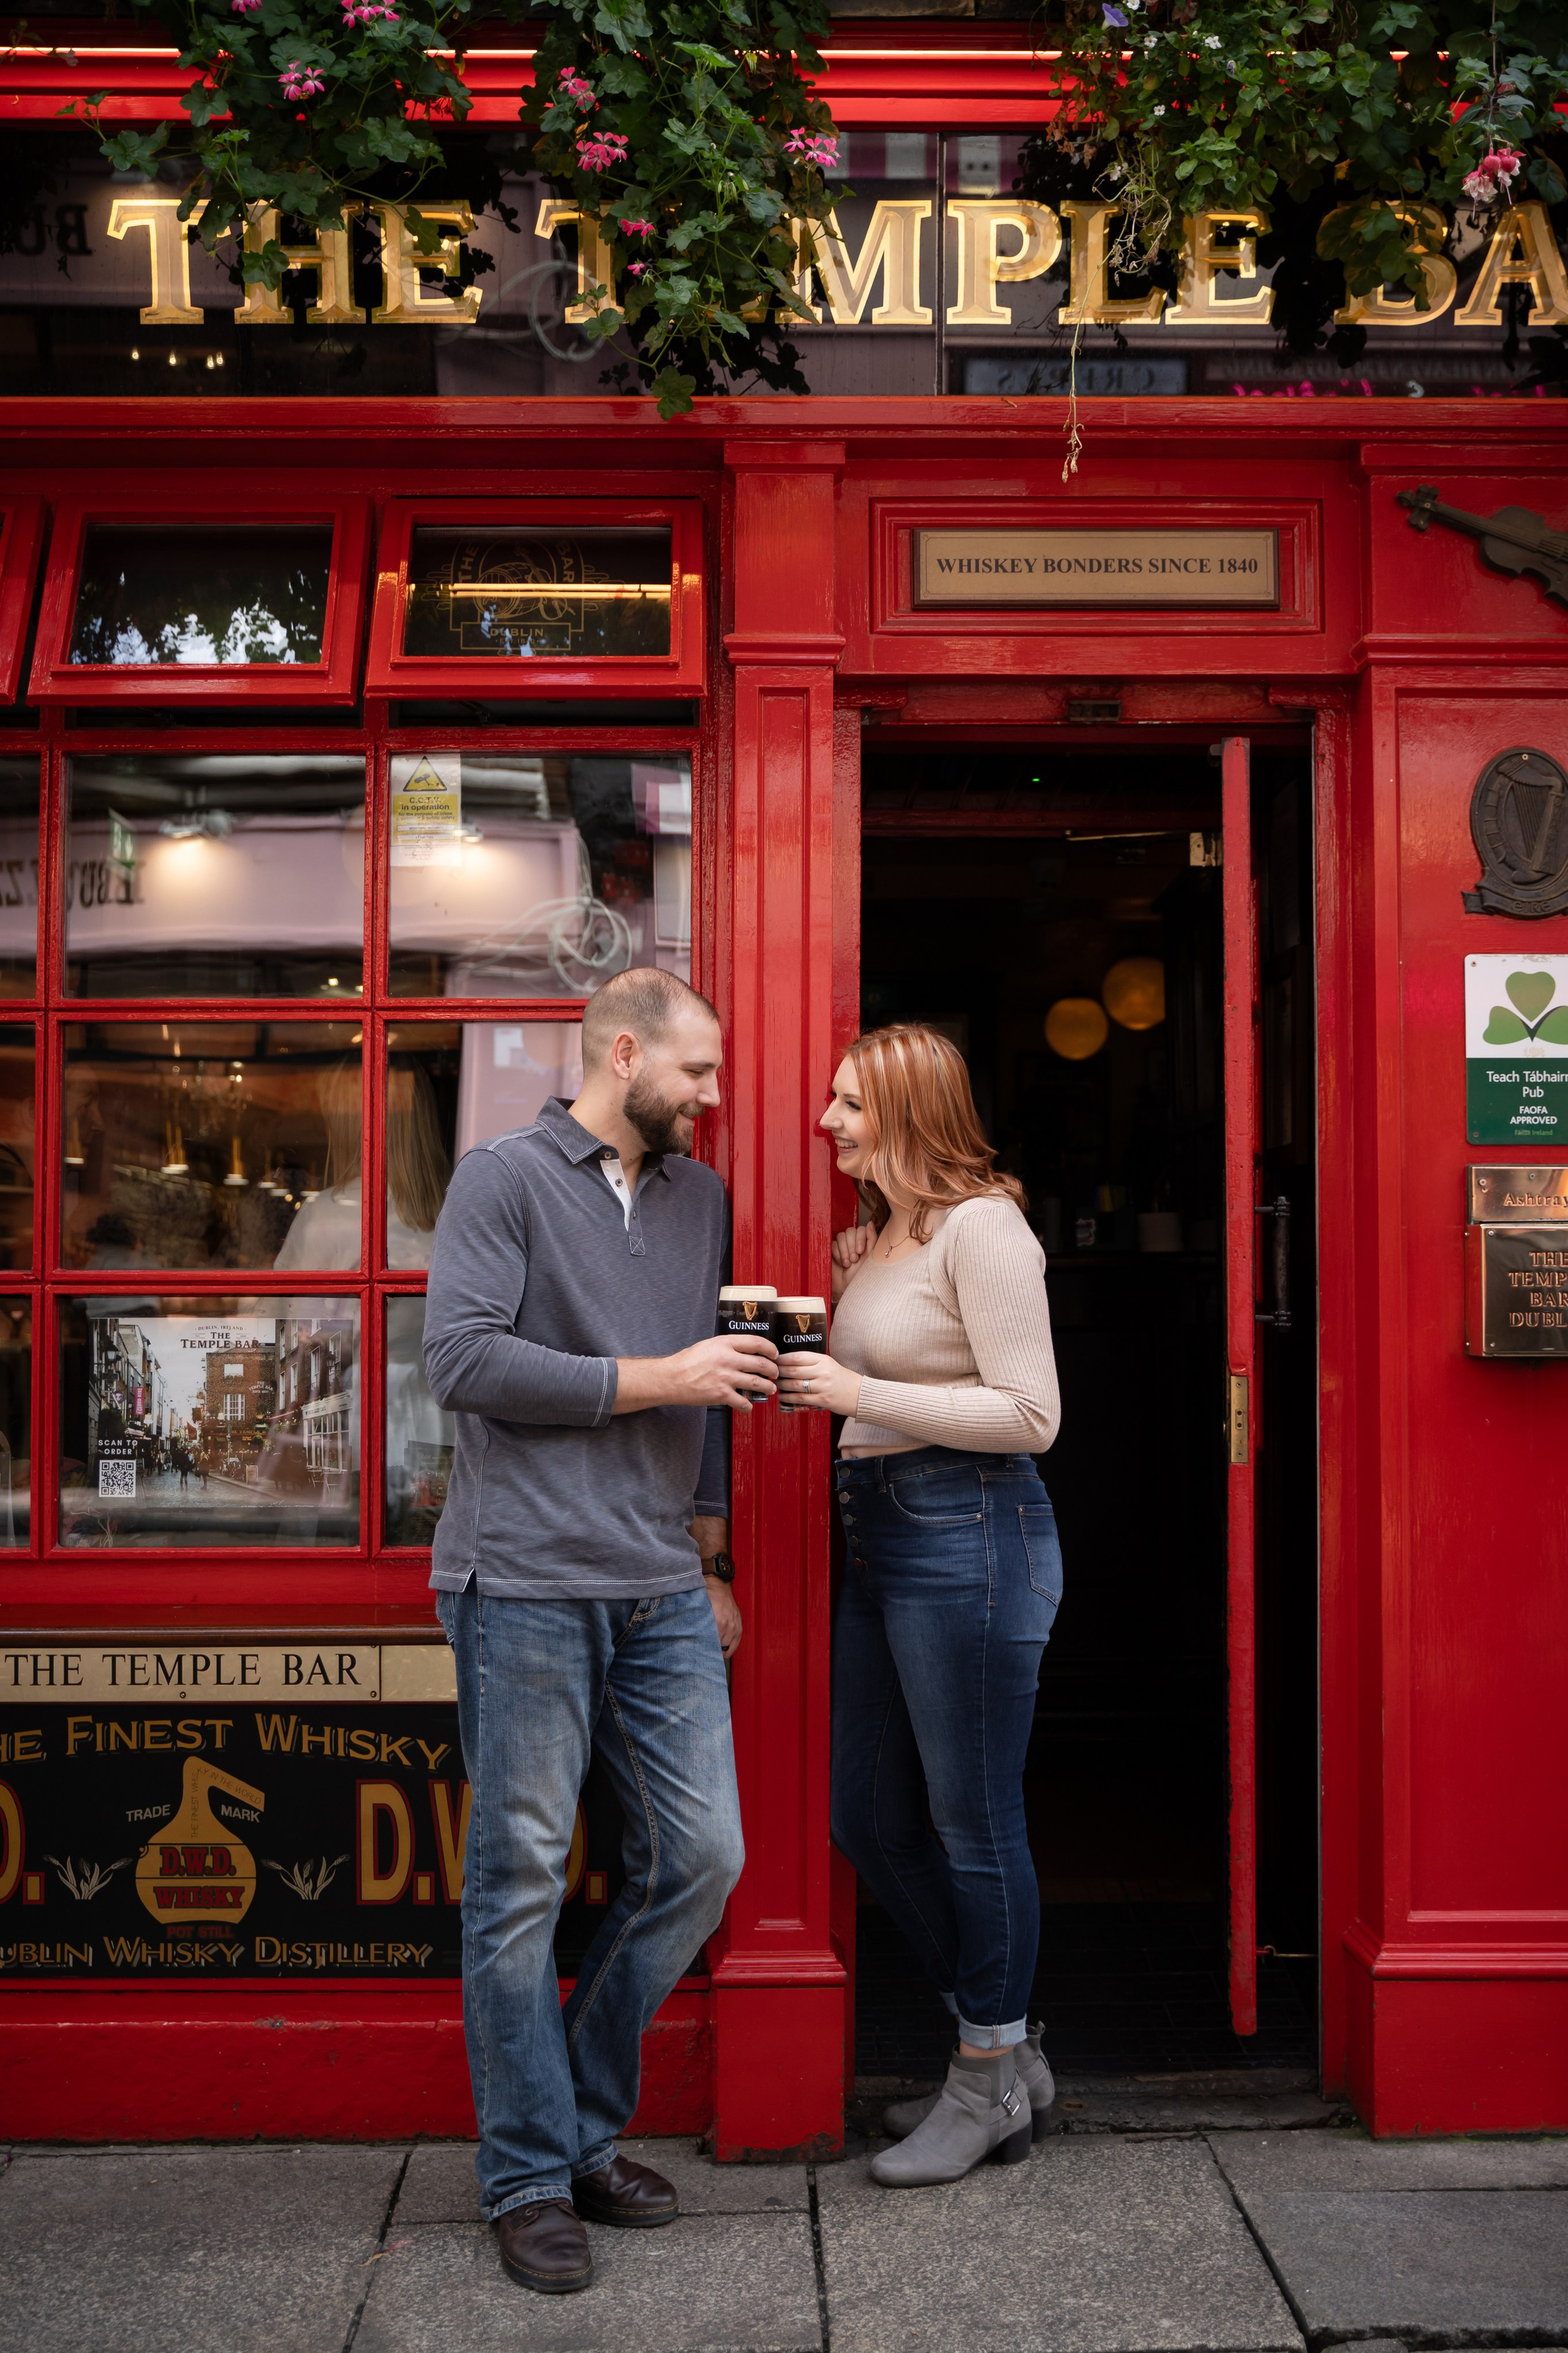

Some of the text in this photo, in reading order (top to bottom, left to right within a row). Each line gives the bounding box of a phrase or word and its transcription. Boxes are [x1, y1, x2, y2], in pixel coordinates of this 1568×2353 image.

[107, 199, 484, 325] THE
[534, 199, 1276, 325] TMPLE
[937, 557, 1258, 573] WHISKEY BONDERS SINCE 1840
[1486, 1070, 1520, 1082] Teach
[1522, 1086, 1544, 1097] Pub
[728, 1321, 769, 1330] GUINNESS
[181, 1339, 260, 1348] TEMPLE BAR
[783, 1333, 822, 1343] GUINNESS
[4, 1653, 362, 1686] THE TEMPLE BAR
[66, 1715, 234, 1756] FINEST
[255, 1713, 449, 1770] WHISKY
[126, 1804, 171, 1822] TRADE
[221, 1804, 260, 1822] MARK
[159, 1846, 237, 1876] D.W.D.
[153, 1886, 245, 1909] WHISKY
[167, 1926, 234, 1938] POT STILL
[103, 1936, 239, 1963] WHISKY
[255, 1936, 429, 1964] DISTILLERY
